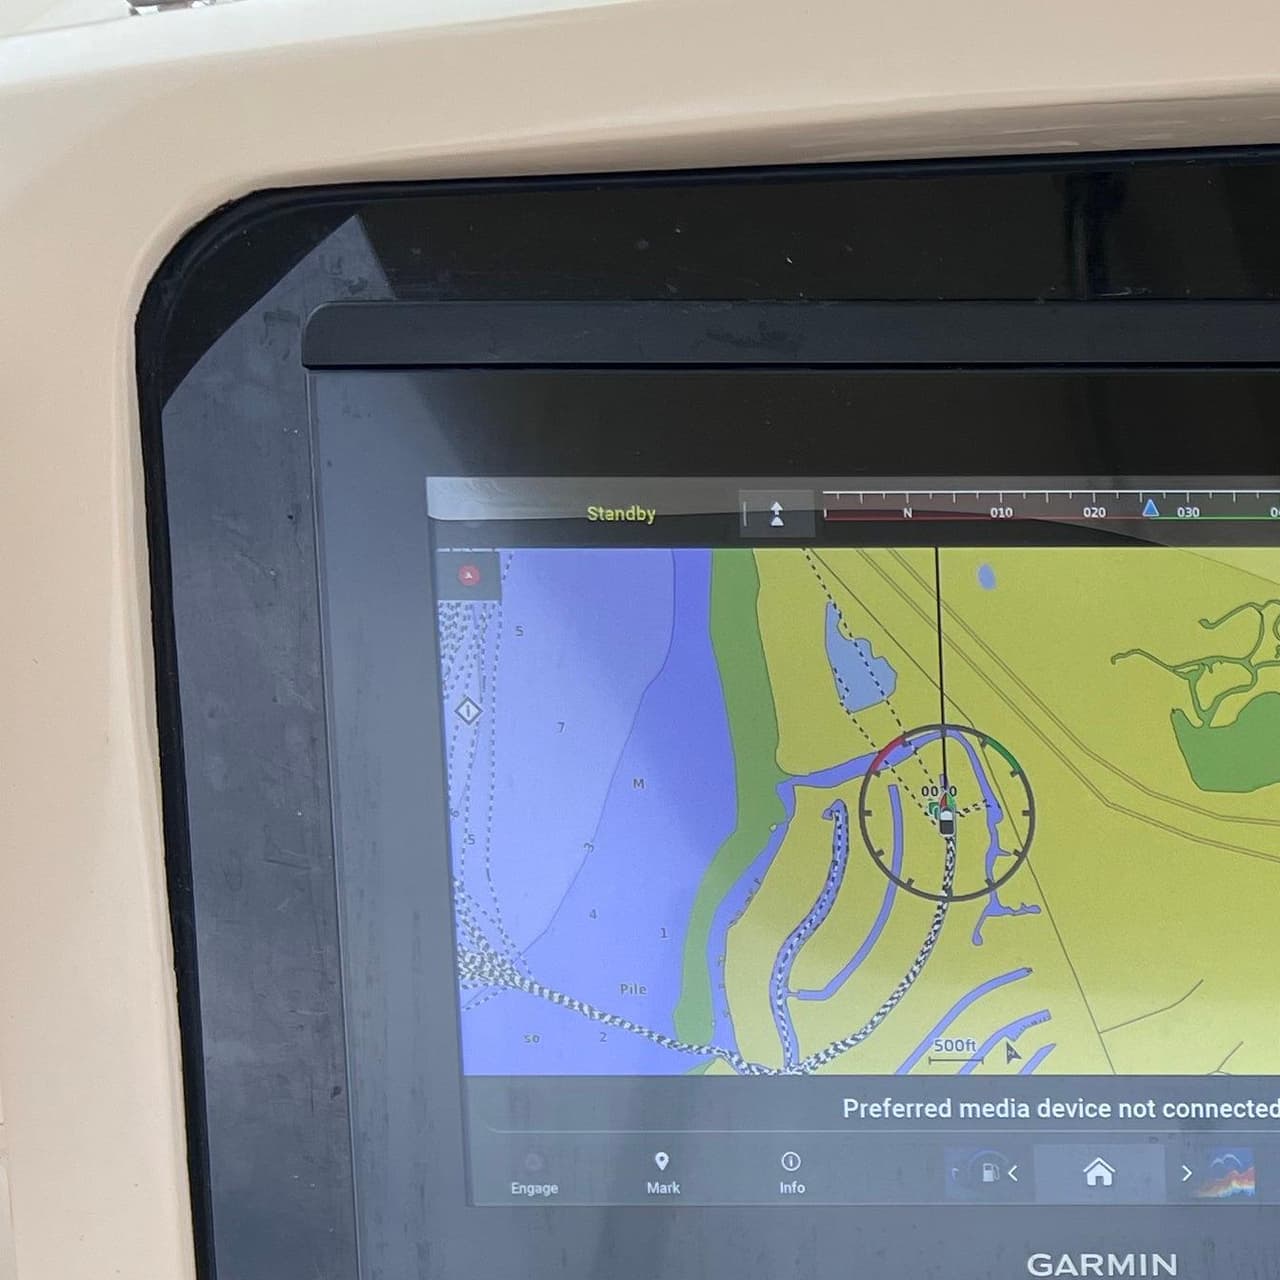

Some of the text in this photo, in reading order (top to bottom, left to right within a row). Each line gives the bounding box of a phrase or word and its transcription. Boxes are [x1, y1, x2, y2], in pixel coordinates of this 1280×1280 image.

[587, 504, 656, 525] Standby
[903, 508, 912, 518] N
[990, 508, 1013, 518] 010
[1084, 508, 1106, 518] 020
[1177, 508, 1200, 518] 030
[620, 983, 647, 995] Pile
[934, 1038, 976, 1053] 500ft
[843, 1097, 952, 1119] Preferred
[960, 1097, 1030, 1119] media
[1037, 1097, 1112, 1119] device
[1118, 1099, 1156, 1119] not
[511, 1181, 559, 1197] Engage
[647, 1180, 680, 1195] Mark
[779, 1180, 805, 1195] Info
[1027, 1253, 1178, 1277] GARMIN
